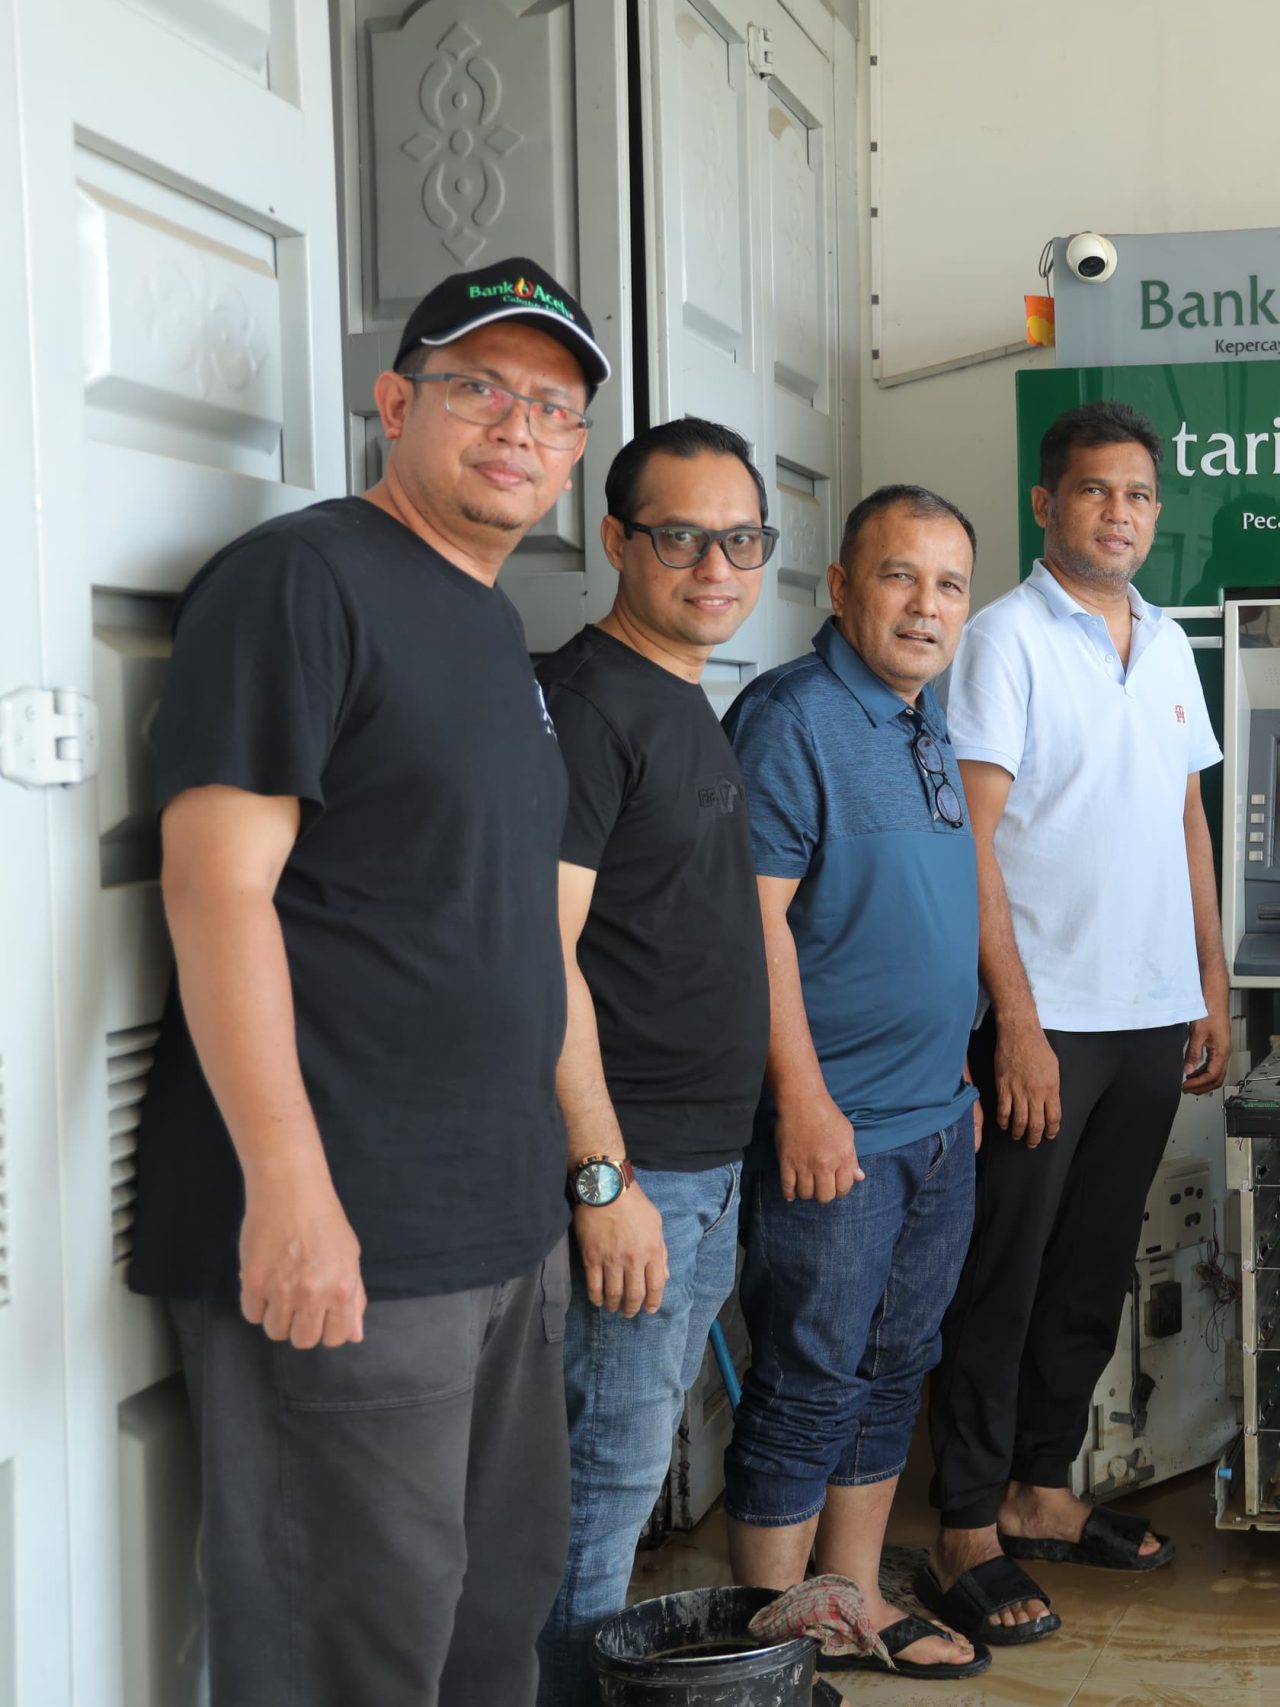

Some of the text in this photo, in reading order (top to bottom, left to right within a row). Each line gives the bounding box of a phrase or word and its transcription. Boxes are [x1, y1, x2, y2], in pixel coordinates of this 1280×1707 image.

[469, 281, 570, 318] Bank Aceh
[1140, 274, 1280, 330] Bank
